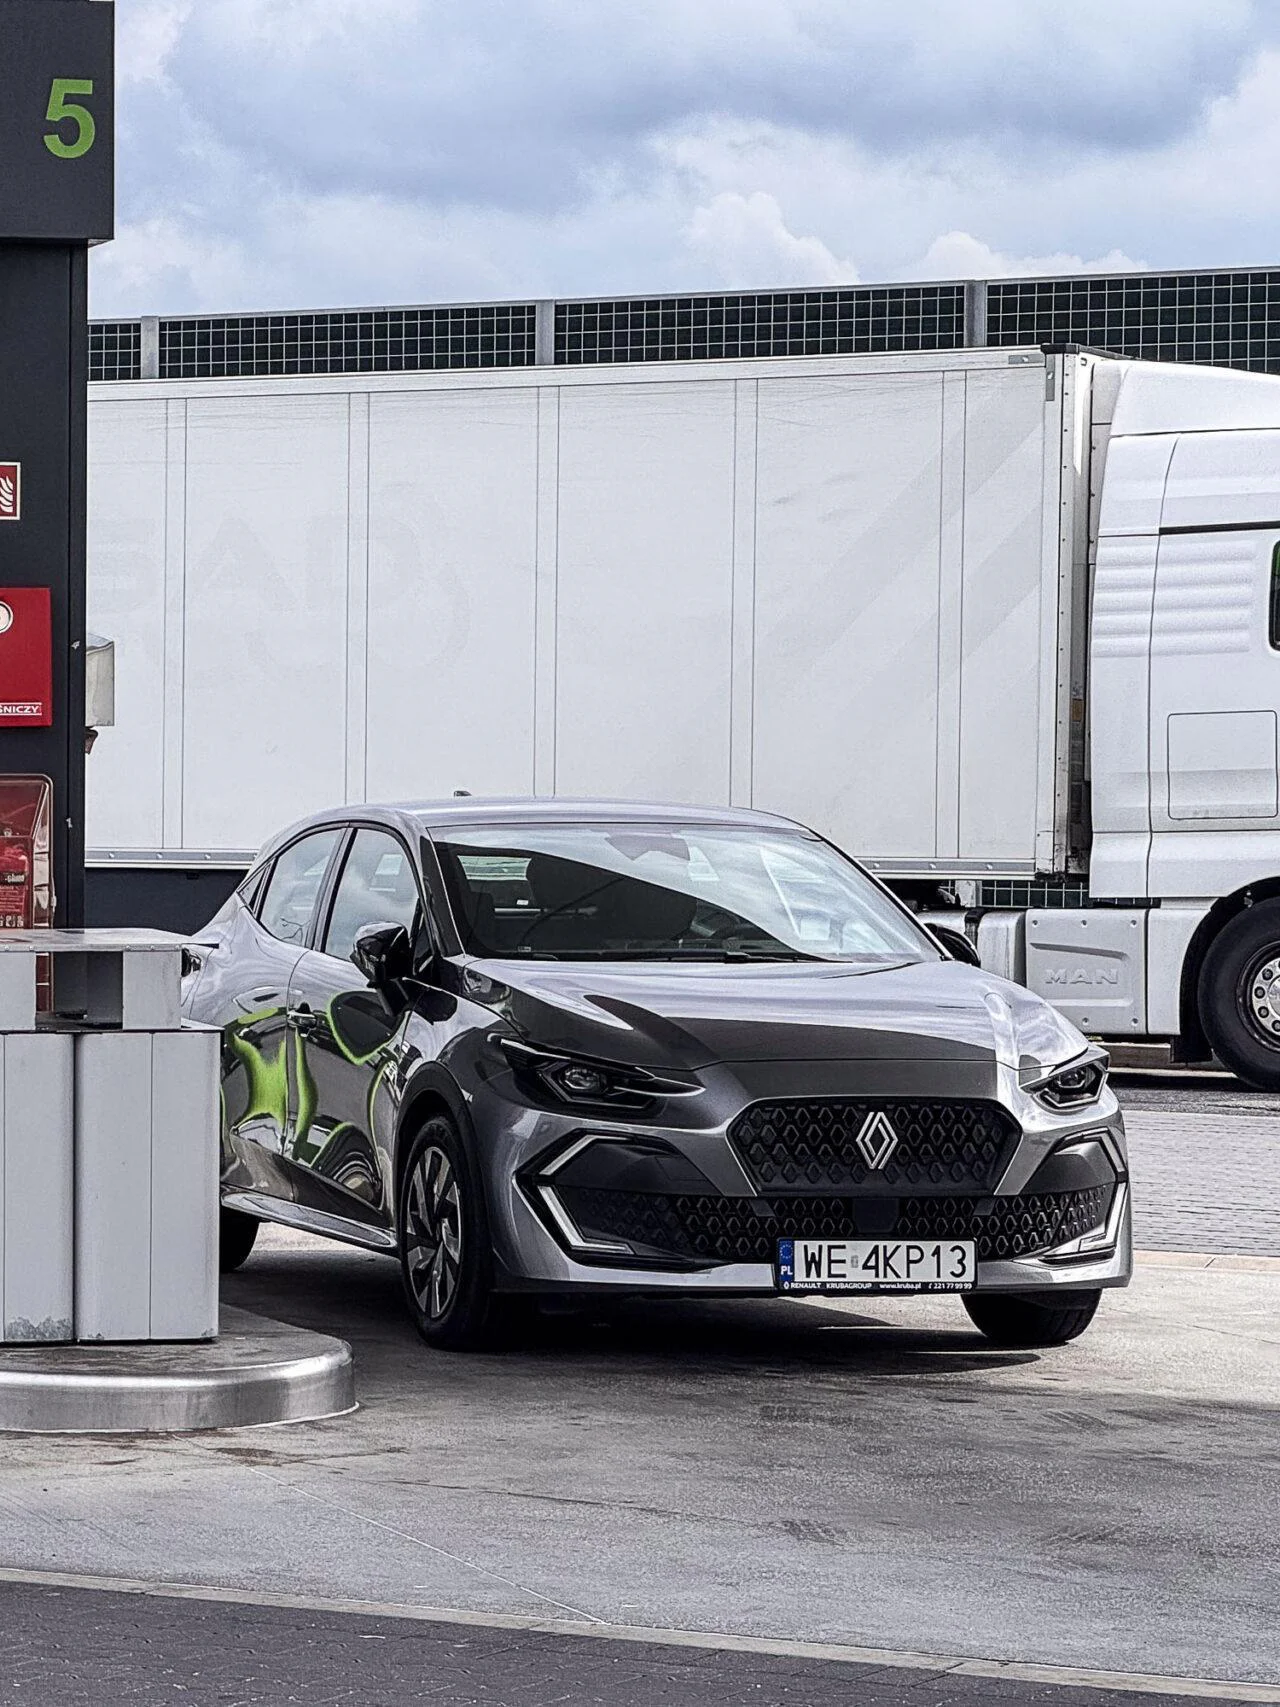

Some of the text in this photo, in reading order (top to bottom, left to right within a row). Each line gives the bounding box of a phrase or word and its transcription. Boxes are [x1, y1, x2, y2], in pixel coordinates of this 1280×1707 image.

[43, 78, 96, 159] 5
[1045, 968, 1119, 985] MAN
[780, 1265, 793, 1276] PL
[803, 1244, 967, 1279] WE 4KP13
